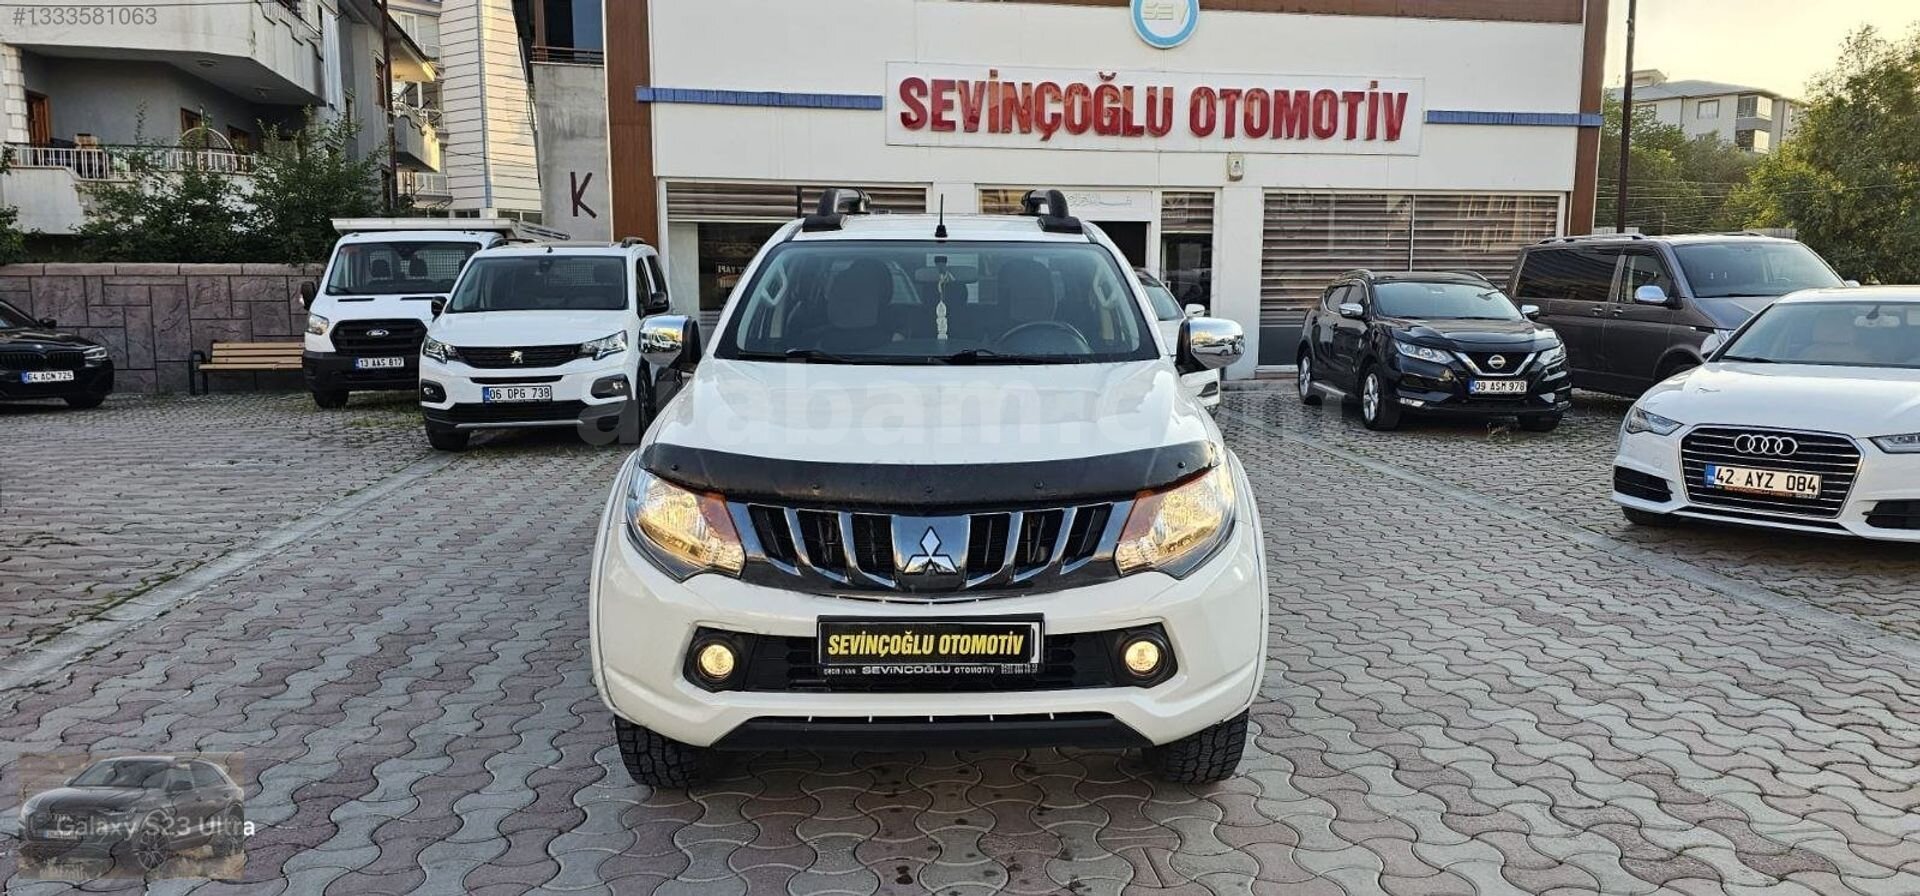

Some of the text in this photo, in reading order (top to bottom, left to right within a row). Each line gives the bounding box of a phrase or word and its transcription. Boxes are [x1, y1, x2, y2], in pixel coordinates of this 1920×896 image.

[899, 69, 1409, 142] SEVİNÇOĞLU OTOMOTİV
[570, 171, 597, 219] K
[489, 387, 550, 400] 06 DPG 738
[1475, 382, 1486, 391] 09
[1509, 381, 1525, 391] 978
[1716, 467, 1735, 485] 42
[1744, 471, 1775, 489] AYZ
[1785, 474, 1817, 493] 084
[828, 630, 1024, 657] SEVİNÇOĞLU OTOMOTİV
